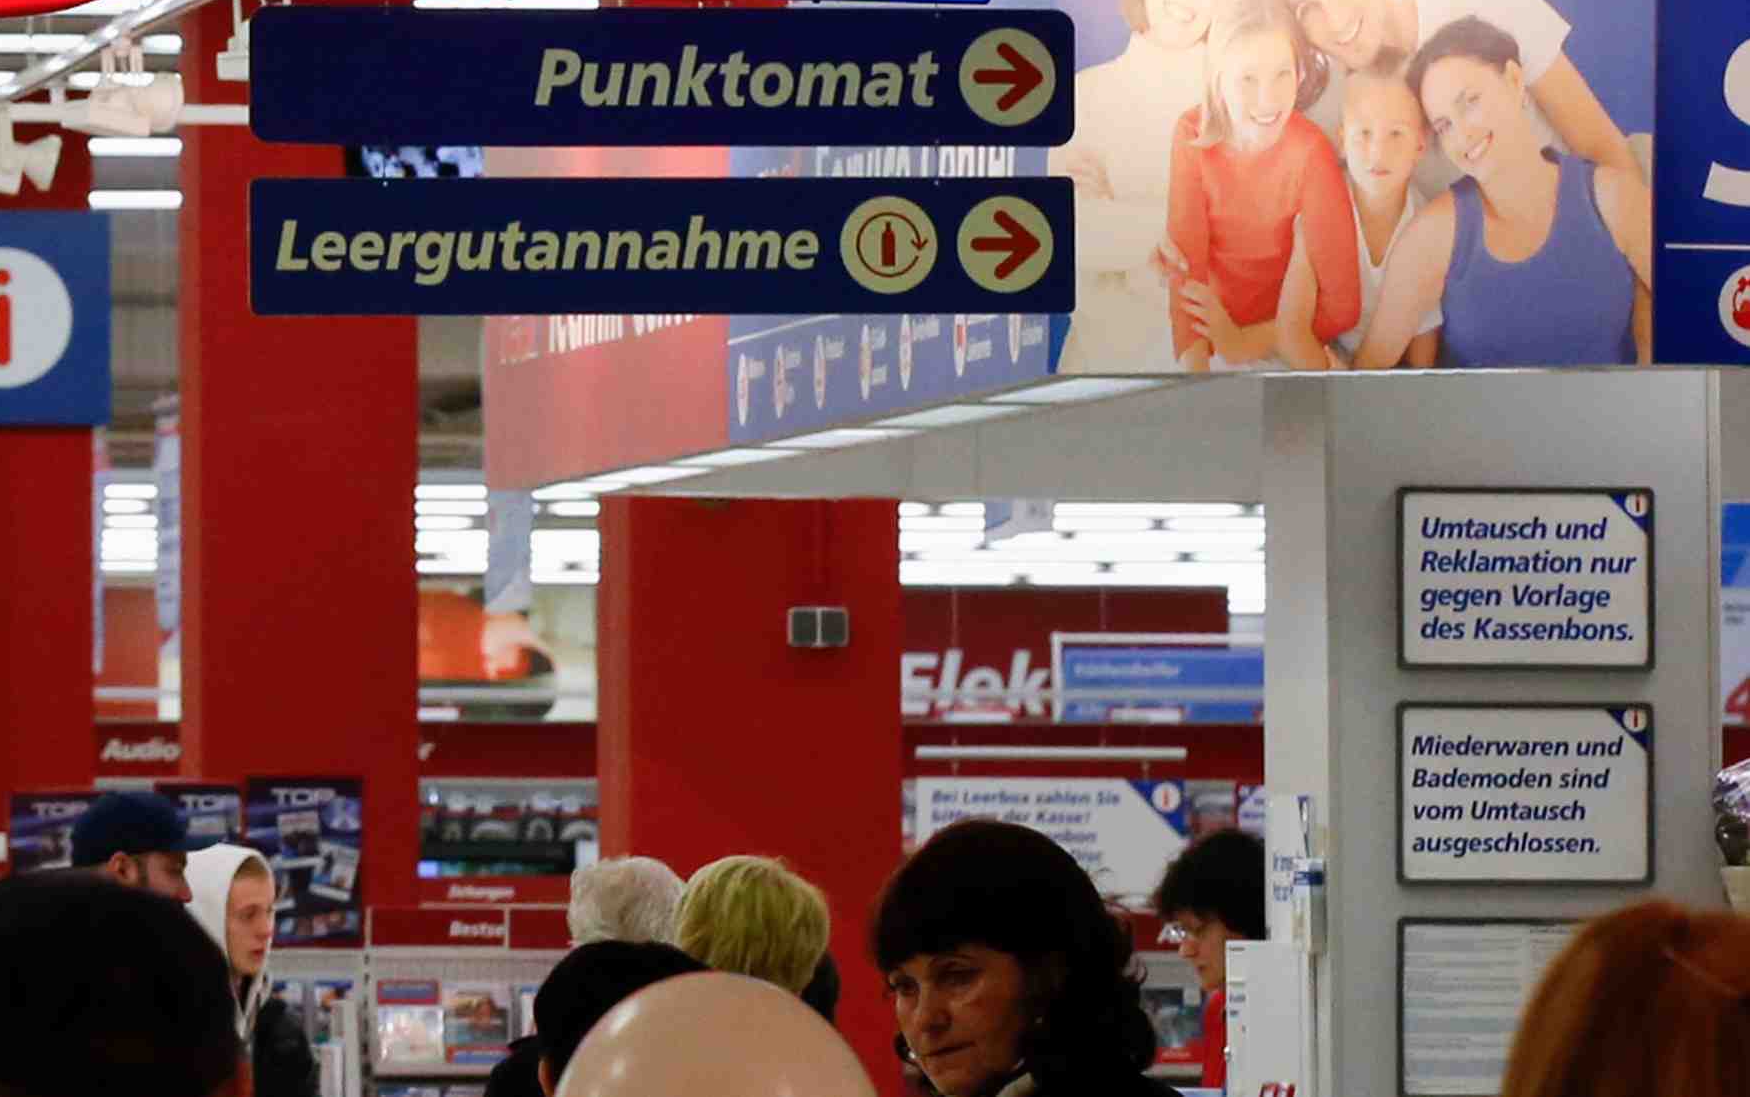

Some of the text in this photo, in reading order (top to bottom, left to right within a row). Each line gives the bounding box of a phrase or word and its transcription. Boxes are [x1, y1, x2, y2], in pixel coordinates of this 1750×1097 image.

[534, 45, 939, 107] Punktomat
[276, 215, 819, 285] Leergutannahme
[1421, 517, 1608, 541] Umtausch und
[1420, 550, 1637, 574] Reklamation nur
[1420, 584, 1610, 614] gegen Vorlage
[1420, 617, 1634, 642] des Kassenbons.
[101, 737, 183, 763] Audio
[1411, 735, 1624, 756] Miederwaren und
[1411, 768, 1610, 789] Bademoden sind
[932, 789, 959, 804] Bei
[1413, 800, 1586, 822] vom Umtausch
[1411, 832, 1601, 858] ausgeschlossen.
